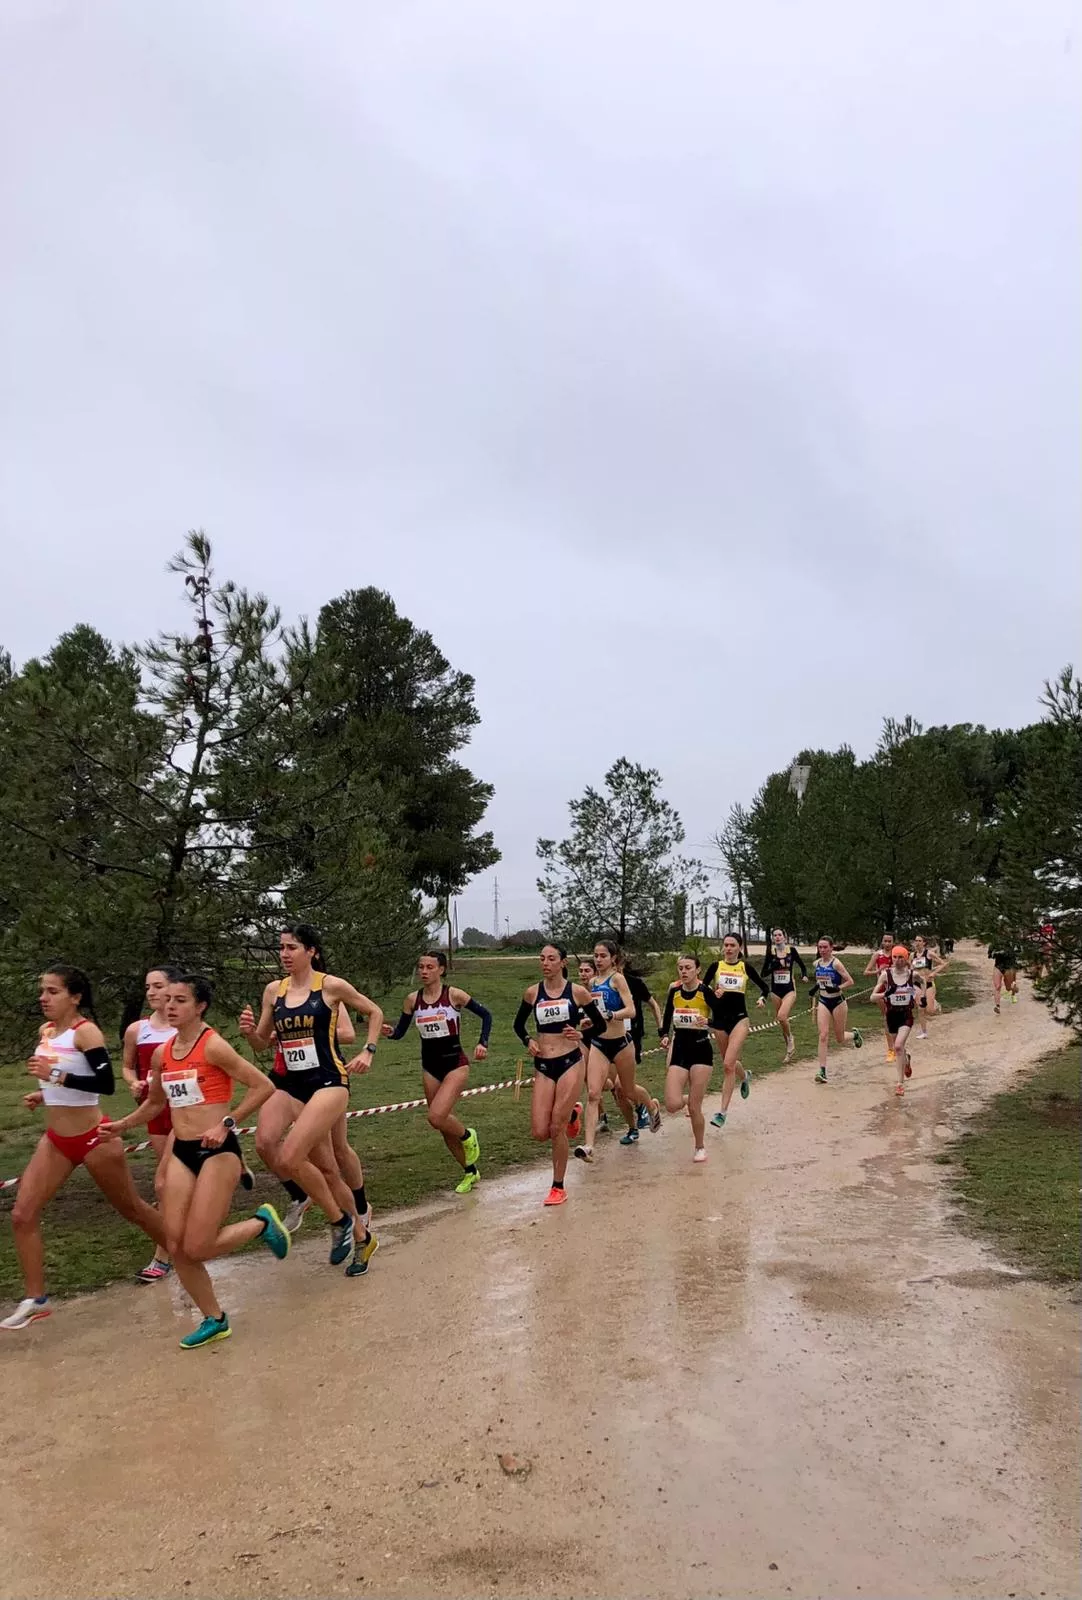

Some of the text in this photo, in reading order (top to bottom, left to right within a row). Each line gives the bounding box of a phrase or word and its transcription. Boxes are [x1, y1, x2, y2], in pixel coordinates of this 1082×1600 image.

[724, 977, 738, 985] 269
[544, 1006, 560, 1018] 203
[275, 1015, 314, 1032] UCAM
[679, 1016, 692, 1024] 261
[423, 1022, 440, 1033] 225
[287, 1049, 306, 1062] 220
[169, 1083, 188, 1098] 284
